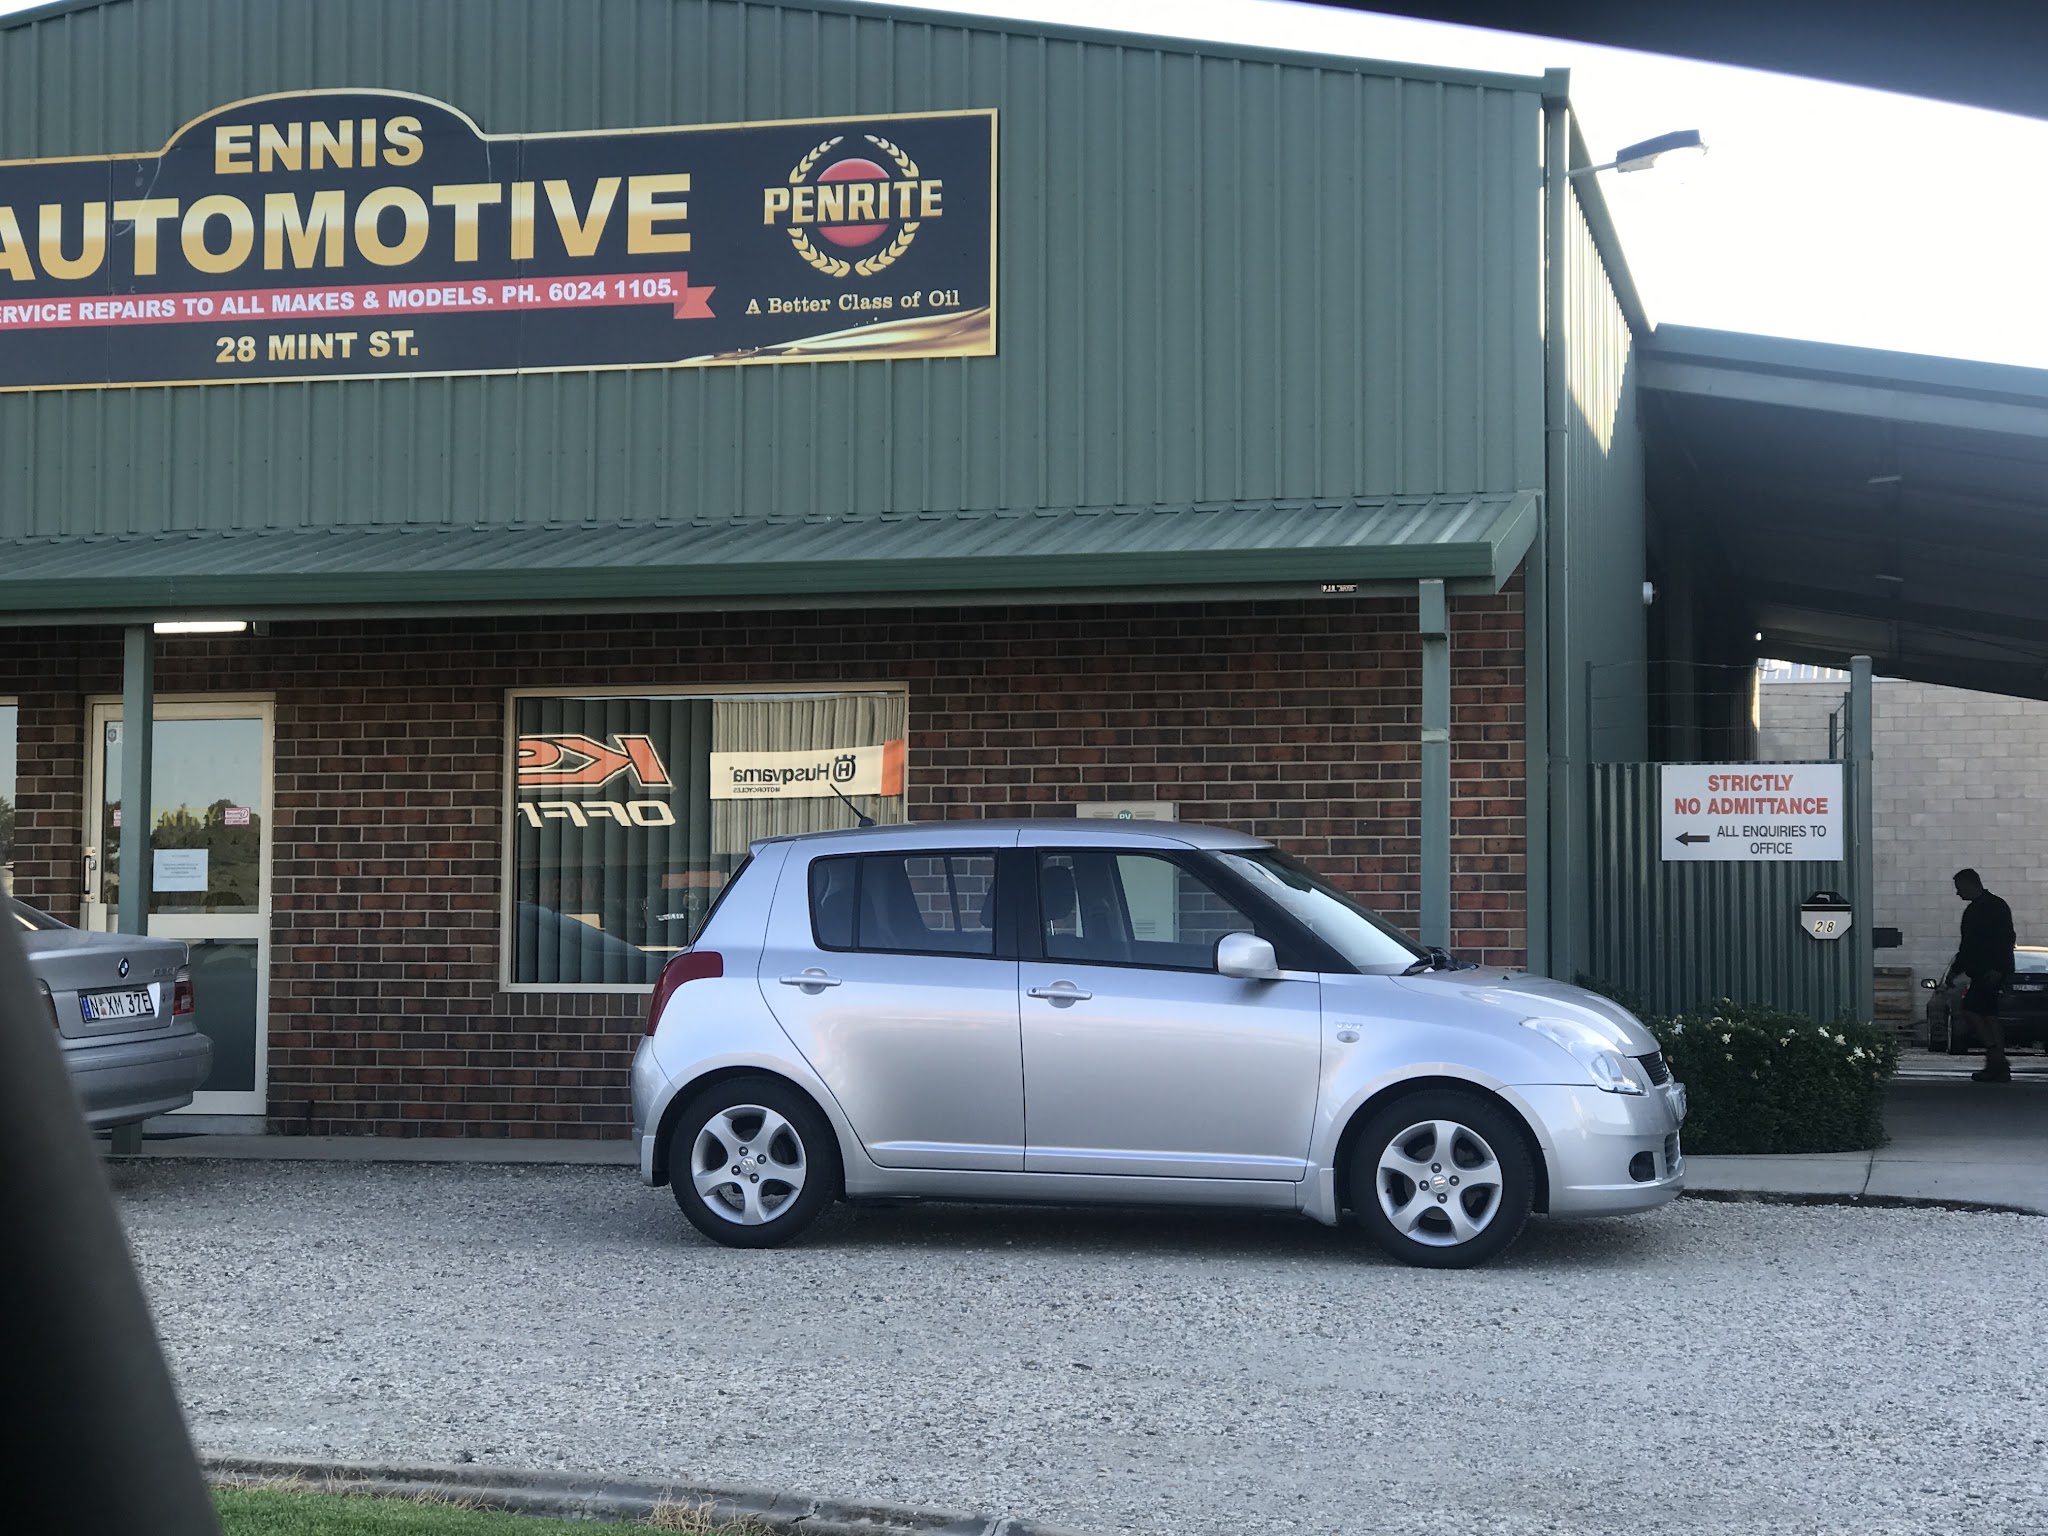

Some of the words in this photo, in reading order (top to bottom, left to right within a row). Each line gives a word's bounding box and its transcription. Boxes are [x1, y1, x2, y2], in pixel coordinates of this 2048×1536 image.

[215, 115, 424, 174] ENNIS
[763, 179, 943, 225] PENRITE
[0, 303, 71, 323] RVICE
[79, 299, 176, 320] REPAIRS
[182, 297, 214, 316] TO
[221, 295, 264, 315] ALL
[271, 291, 355, 313] MAKES
[362, 290, 380, 309] &
[388, 286, 494, 308] MODELS.
[502, 284, 541, 303] PH.
[548, 281, 606, 301] 6024
[614, 278, 679, 298] 1105.
[745, 298, 762, 315] A
[767, 296, 831, 314] Better
[838, 293, 893, 311] Class
[900, 290, 922, 308] of
[928, 289, 960, 307] Oil
[215, 335, 256, 363] 28
[268, 332, 358, 361] MINT
[368, 329, 419, 358] ST.
[1708, 774, 1794, 792] STRICTLY
[1674, 798, 1701, 815] NO
[1707, 797, 1829, 815] ADMITTANCE
[1717, 825, 1739, 838] ALL
[1742, 825, 1807, 838] ENQUIRIES
[1810, 825, 1827, 838] TO
[1750, 842, 1793, 855] OFFICE
[1815, 921, 1834, 932] 28
